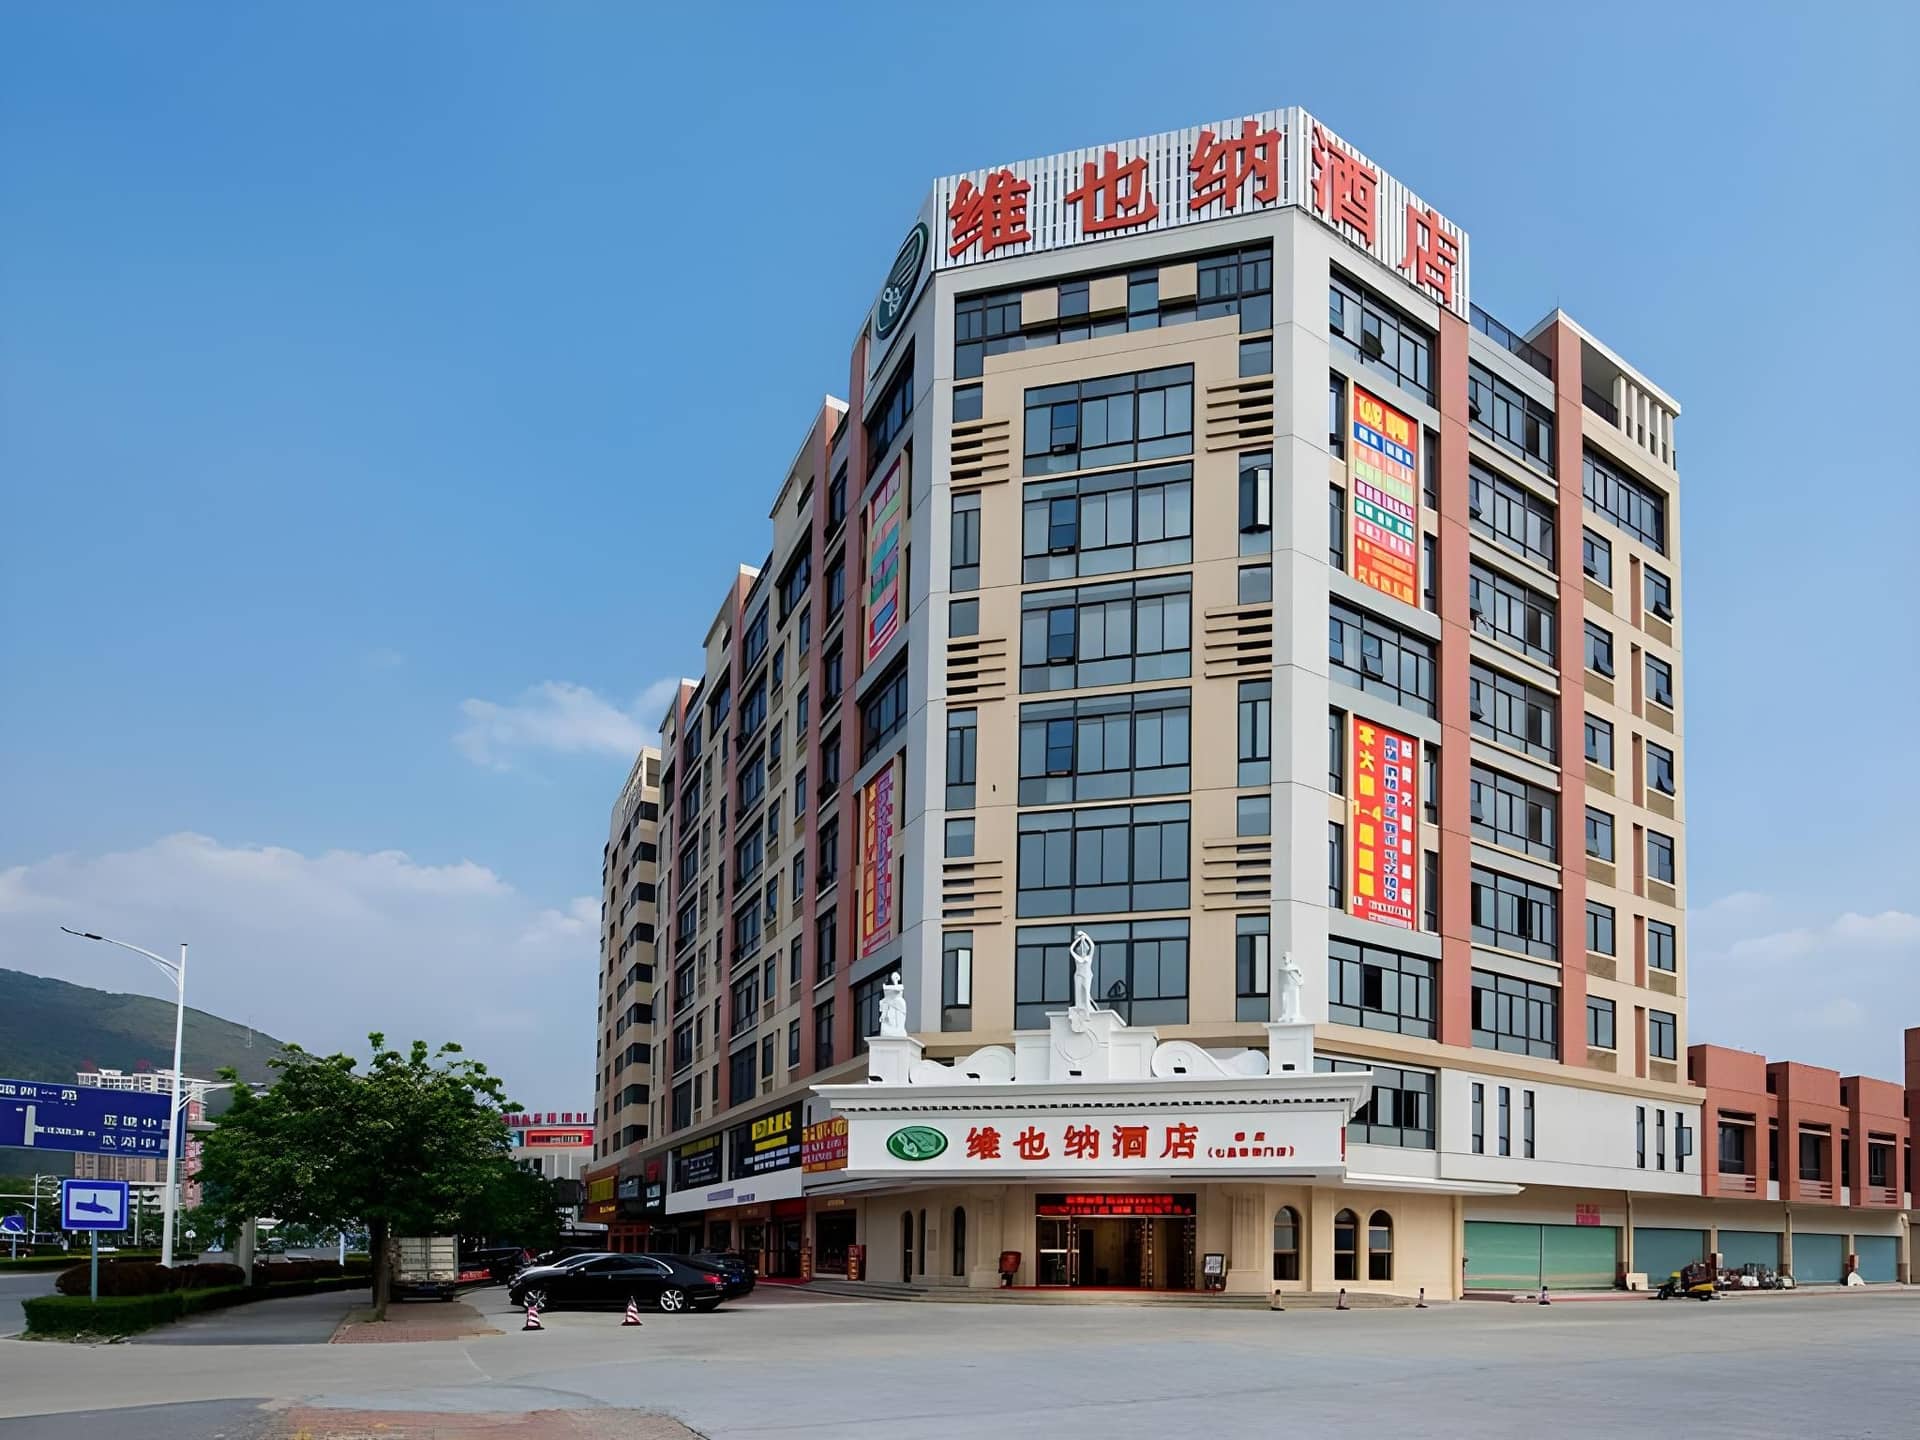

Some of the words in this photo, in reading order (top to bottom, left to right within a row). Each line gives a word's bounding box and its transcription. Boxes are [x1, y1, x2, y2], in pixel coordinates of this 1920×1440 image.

[948, 121, 1281, 258] 维也纳
[1311, 124, 1459, 304] 酒店
[966, 1123, 1199, 1160] 维也纳酒店
